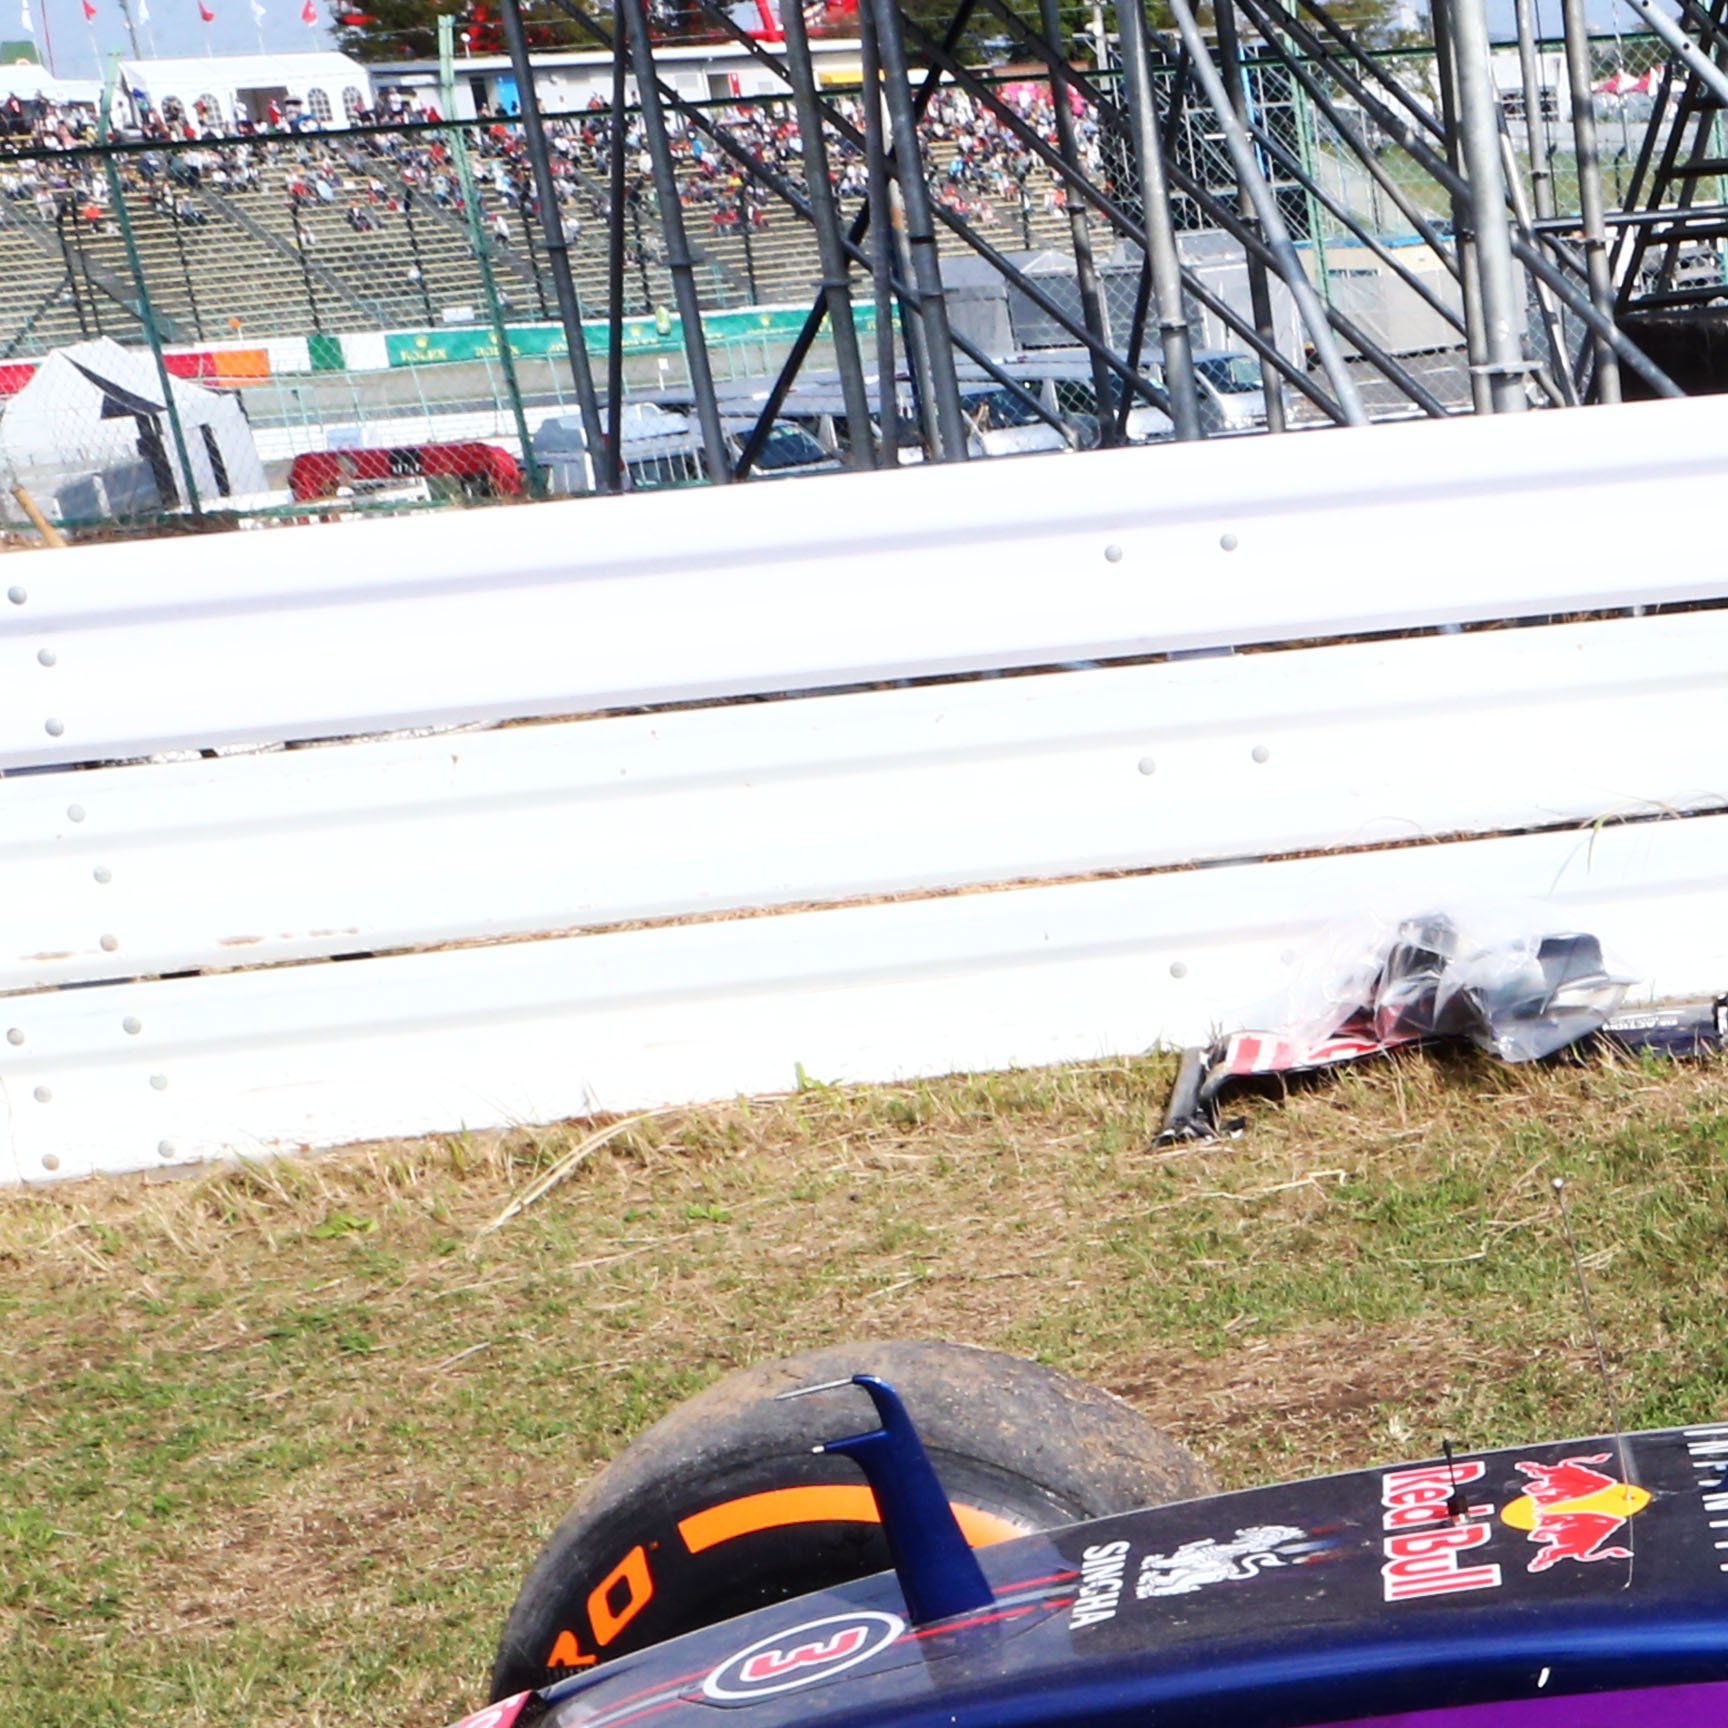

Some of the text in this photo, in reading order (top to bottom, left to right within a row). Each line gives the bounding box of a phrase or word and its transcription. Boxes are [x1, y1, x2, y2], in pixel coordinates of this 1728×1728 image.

[1381, 1461, 1503, 1602] Red Bull
[740, 1625, 870, 1682] 3
